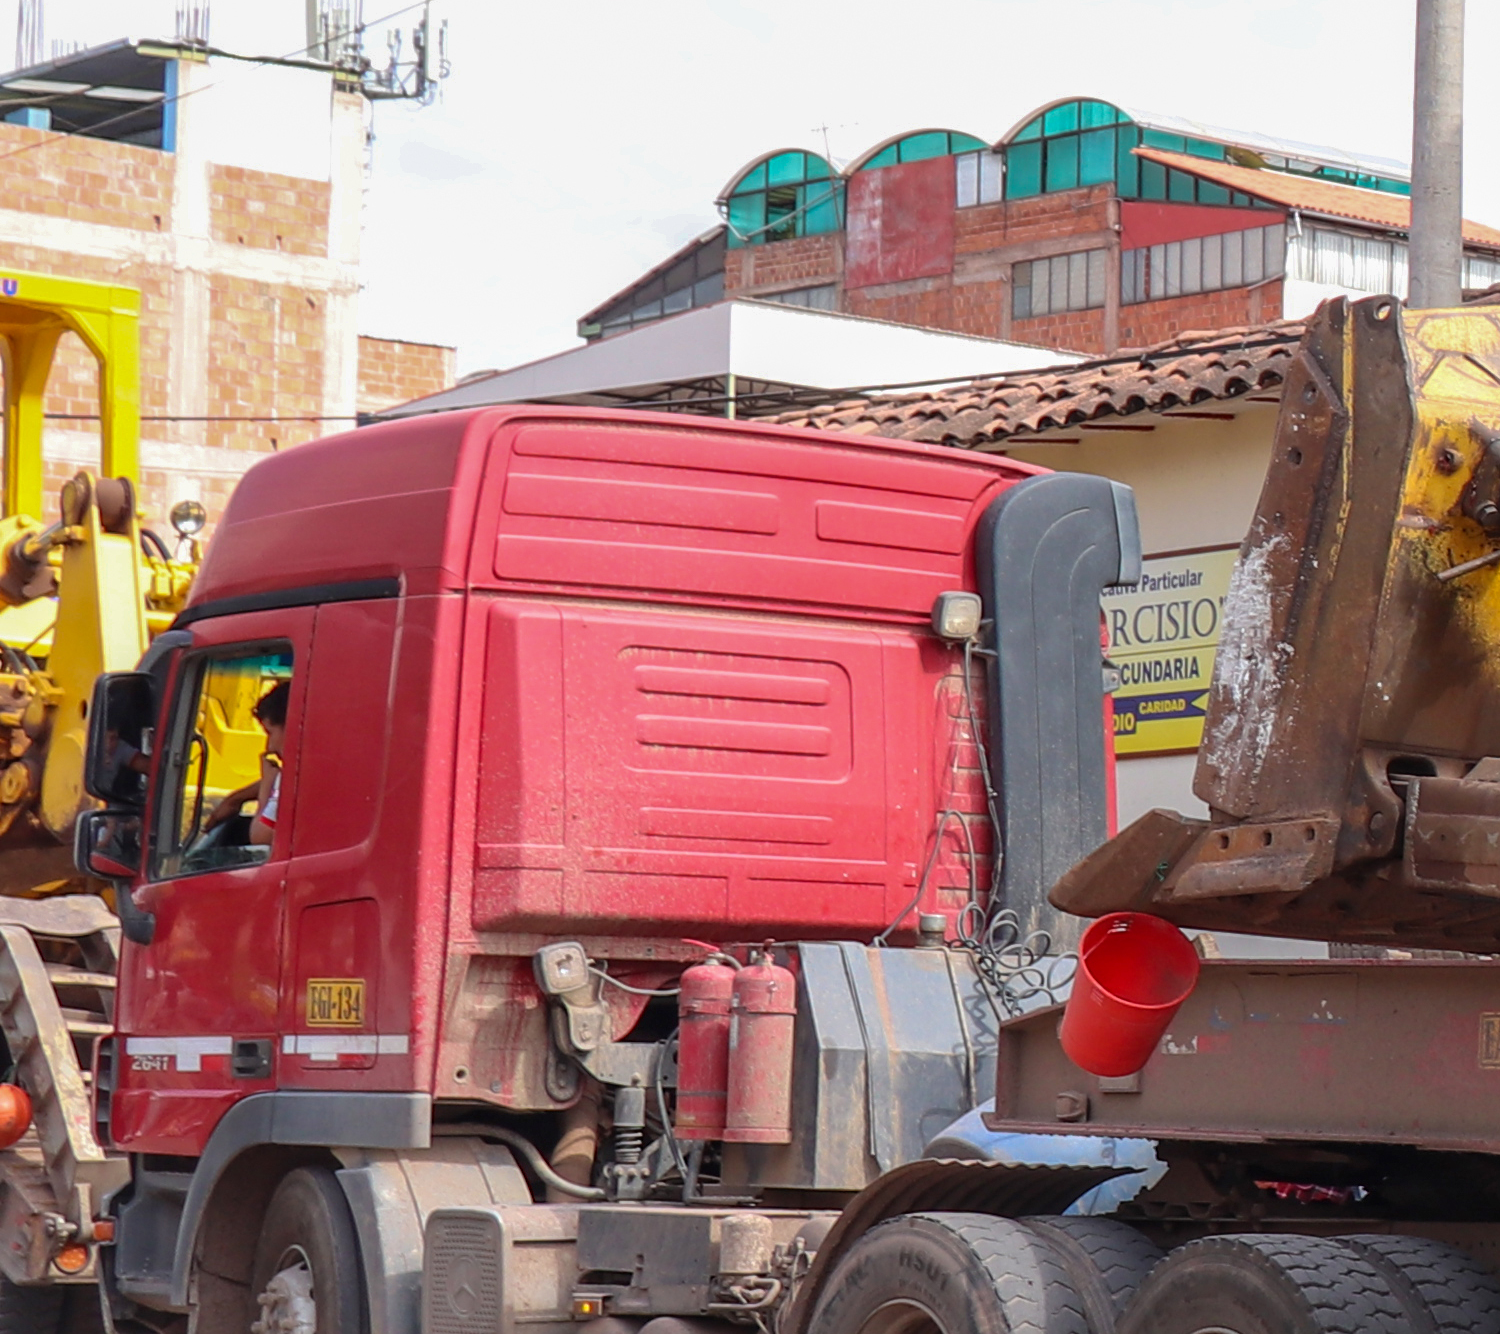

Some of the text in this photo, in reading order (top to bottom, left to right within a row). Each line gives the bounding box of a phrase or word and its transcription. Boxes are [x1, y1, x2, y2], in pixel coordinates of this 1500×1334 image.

[1101, 569, 1204, 597] cativa Particular
[1109, 595, 1229, 647] RCISIO"
[1121, 655, 1200, 686] CUNDARIA
[1139, 698, 1187, 715] CARIDAD
[1112, 712, 1135, 732] DIO
